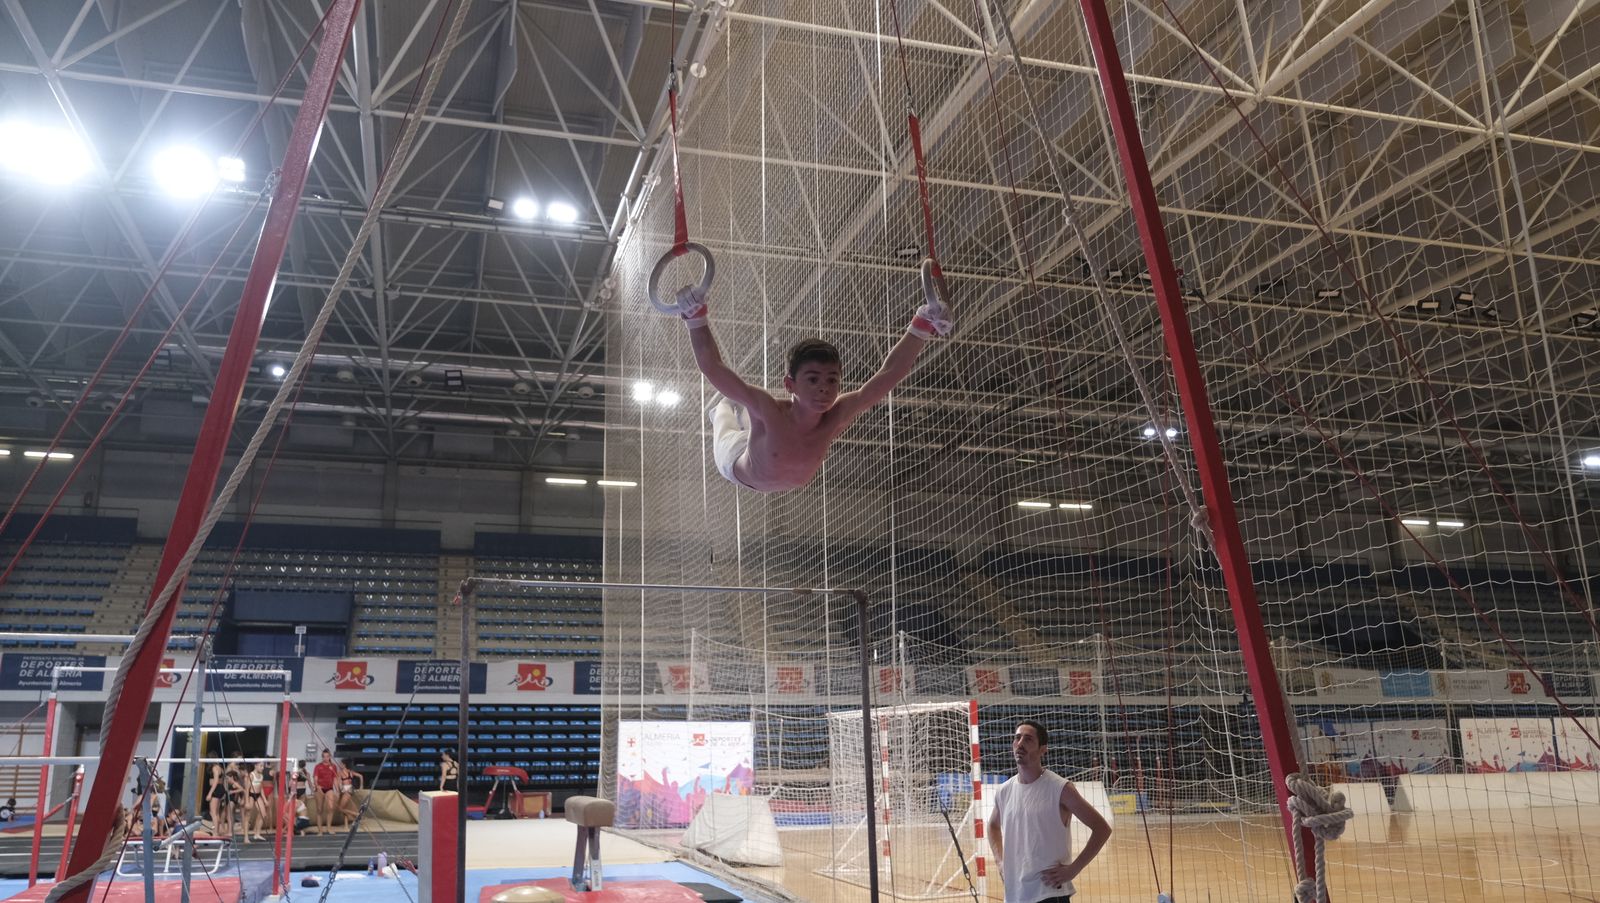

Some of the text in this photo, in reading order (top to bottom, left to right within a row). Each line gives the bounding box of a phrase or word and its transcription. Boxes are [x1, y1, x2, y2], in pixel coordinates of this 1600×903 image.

[21, 661, 85, 669] DEPORTES
[19, 669, 82, 677] DE ALERIA
[223, 671, 237, 679] DE
[428, 674, 461, 682] ALMER
